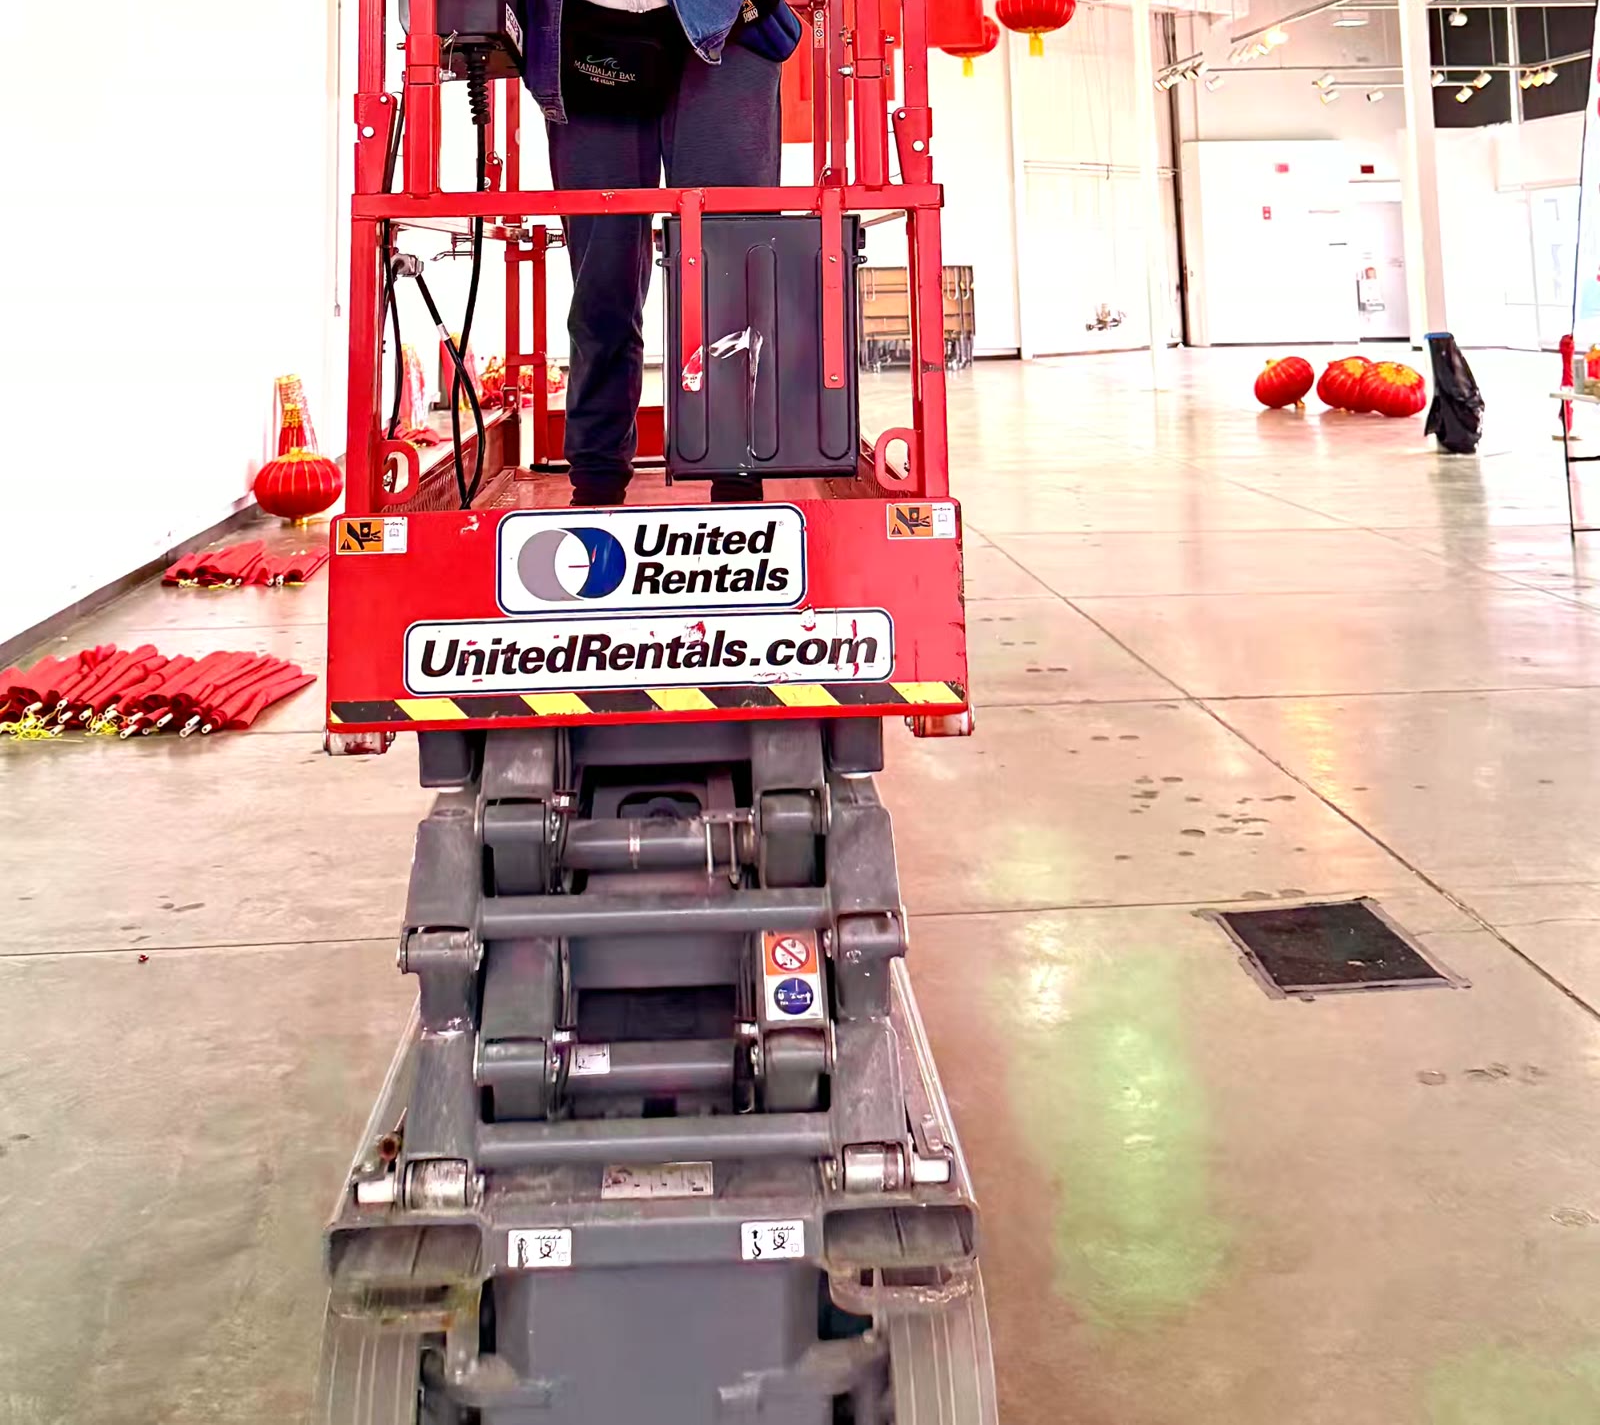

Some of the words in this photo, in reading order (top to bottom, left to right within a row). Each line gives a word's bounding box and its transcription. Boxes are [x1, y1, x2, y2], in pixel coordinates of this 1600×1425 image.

[574, 60, 617, 78] MANDALAY
[619, 71, 636, 81] BAY
[633, 521, 777, 557] United
[632, 558, 789, 595] Rentals
[420, 629, 878, 677] UnitedRentals.com
